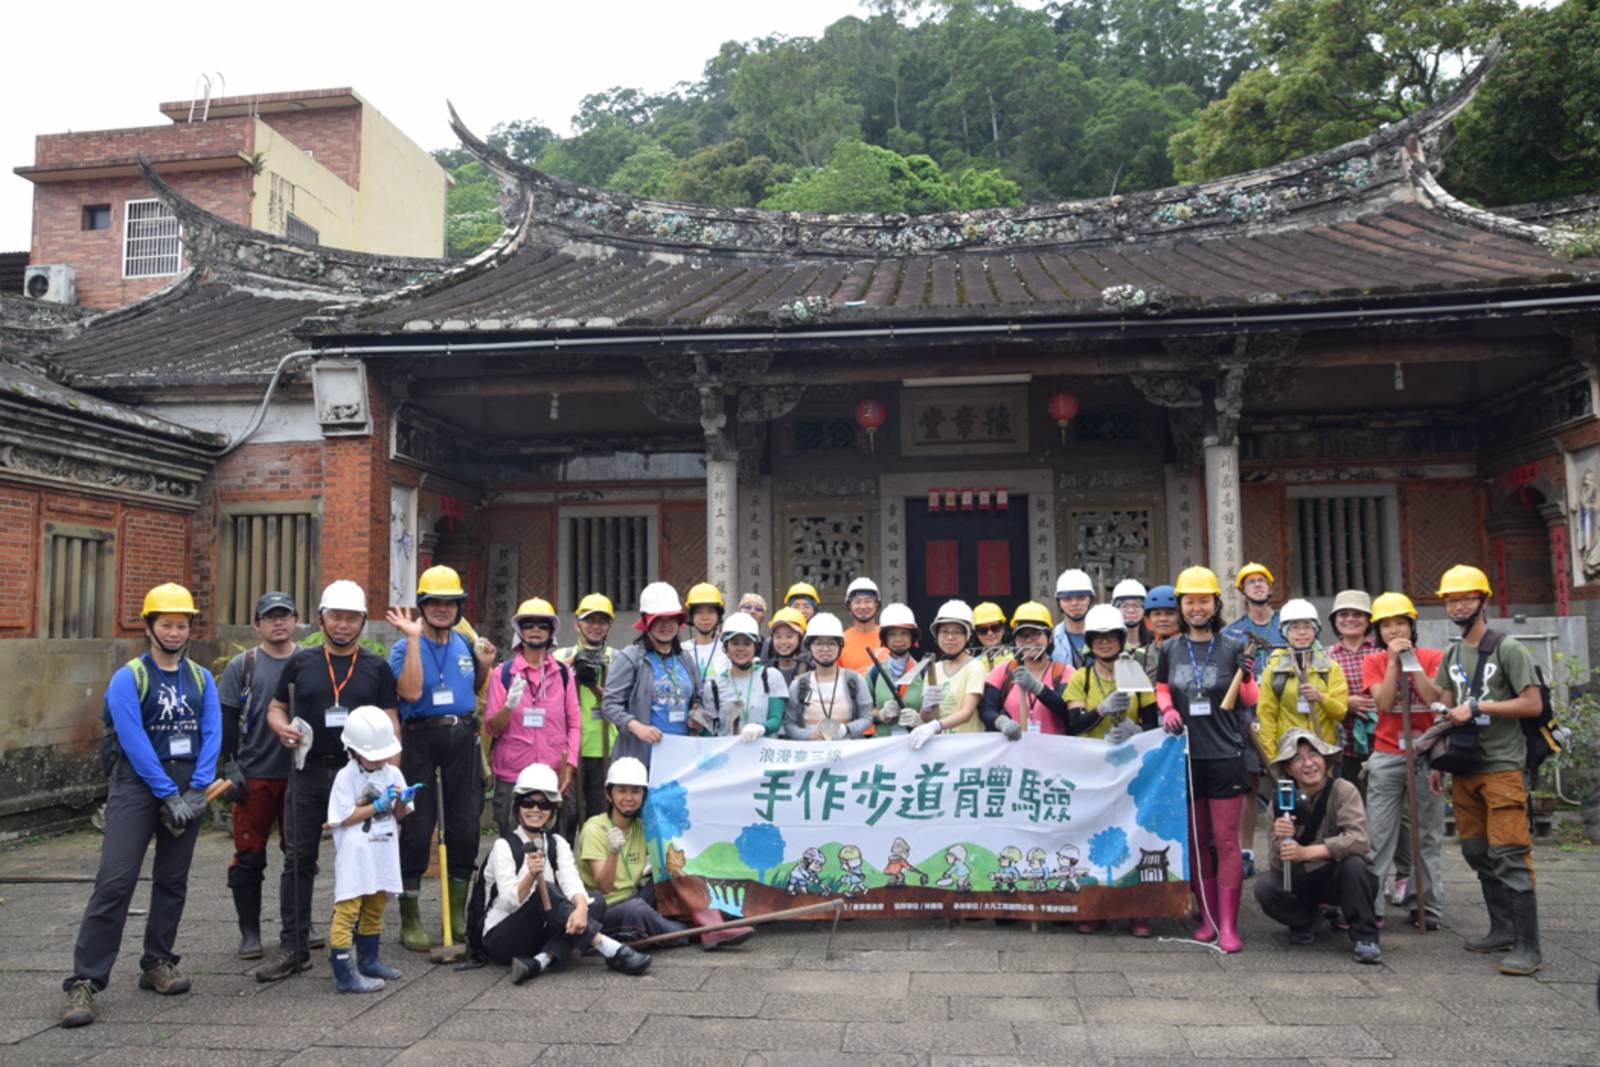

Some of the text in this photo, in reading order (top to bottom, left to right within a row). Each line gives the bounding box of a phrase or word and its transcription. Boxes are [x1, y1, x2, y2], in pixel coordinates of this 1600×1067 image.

[752, 761, 1077, 827] 手作步道體驗
